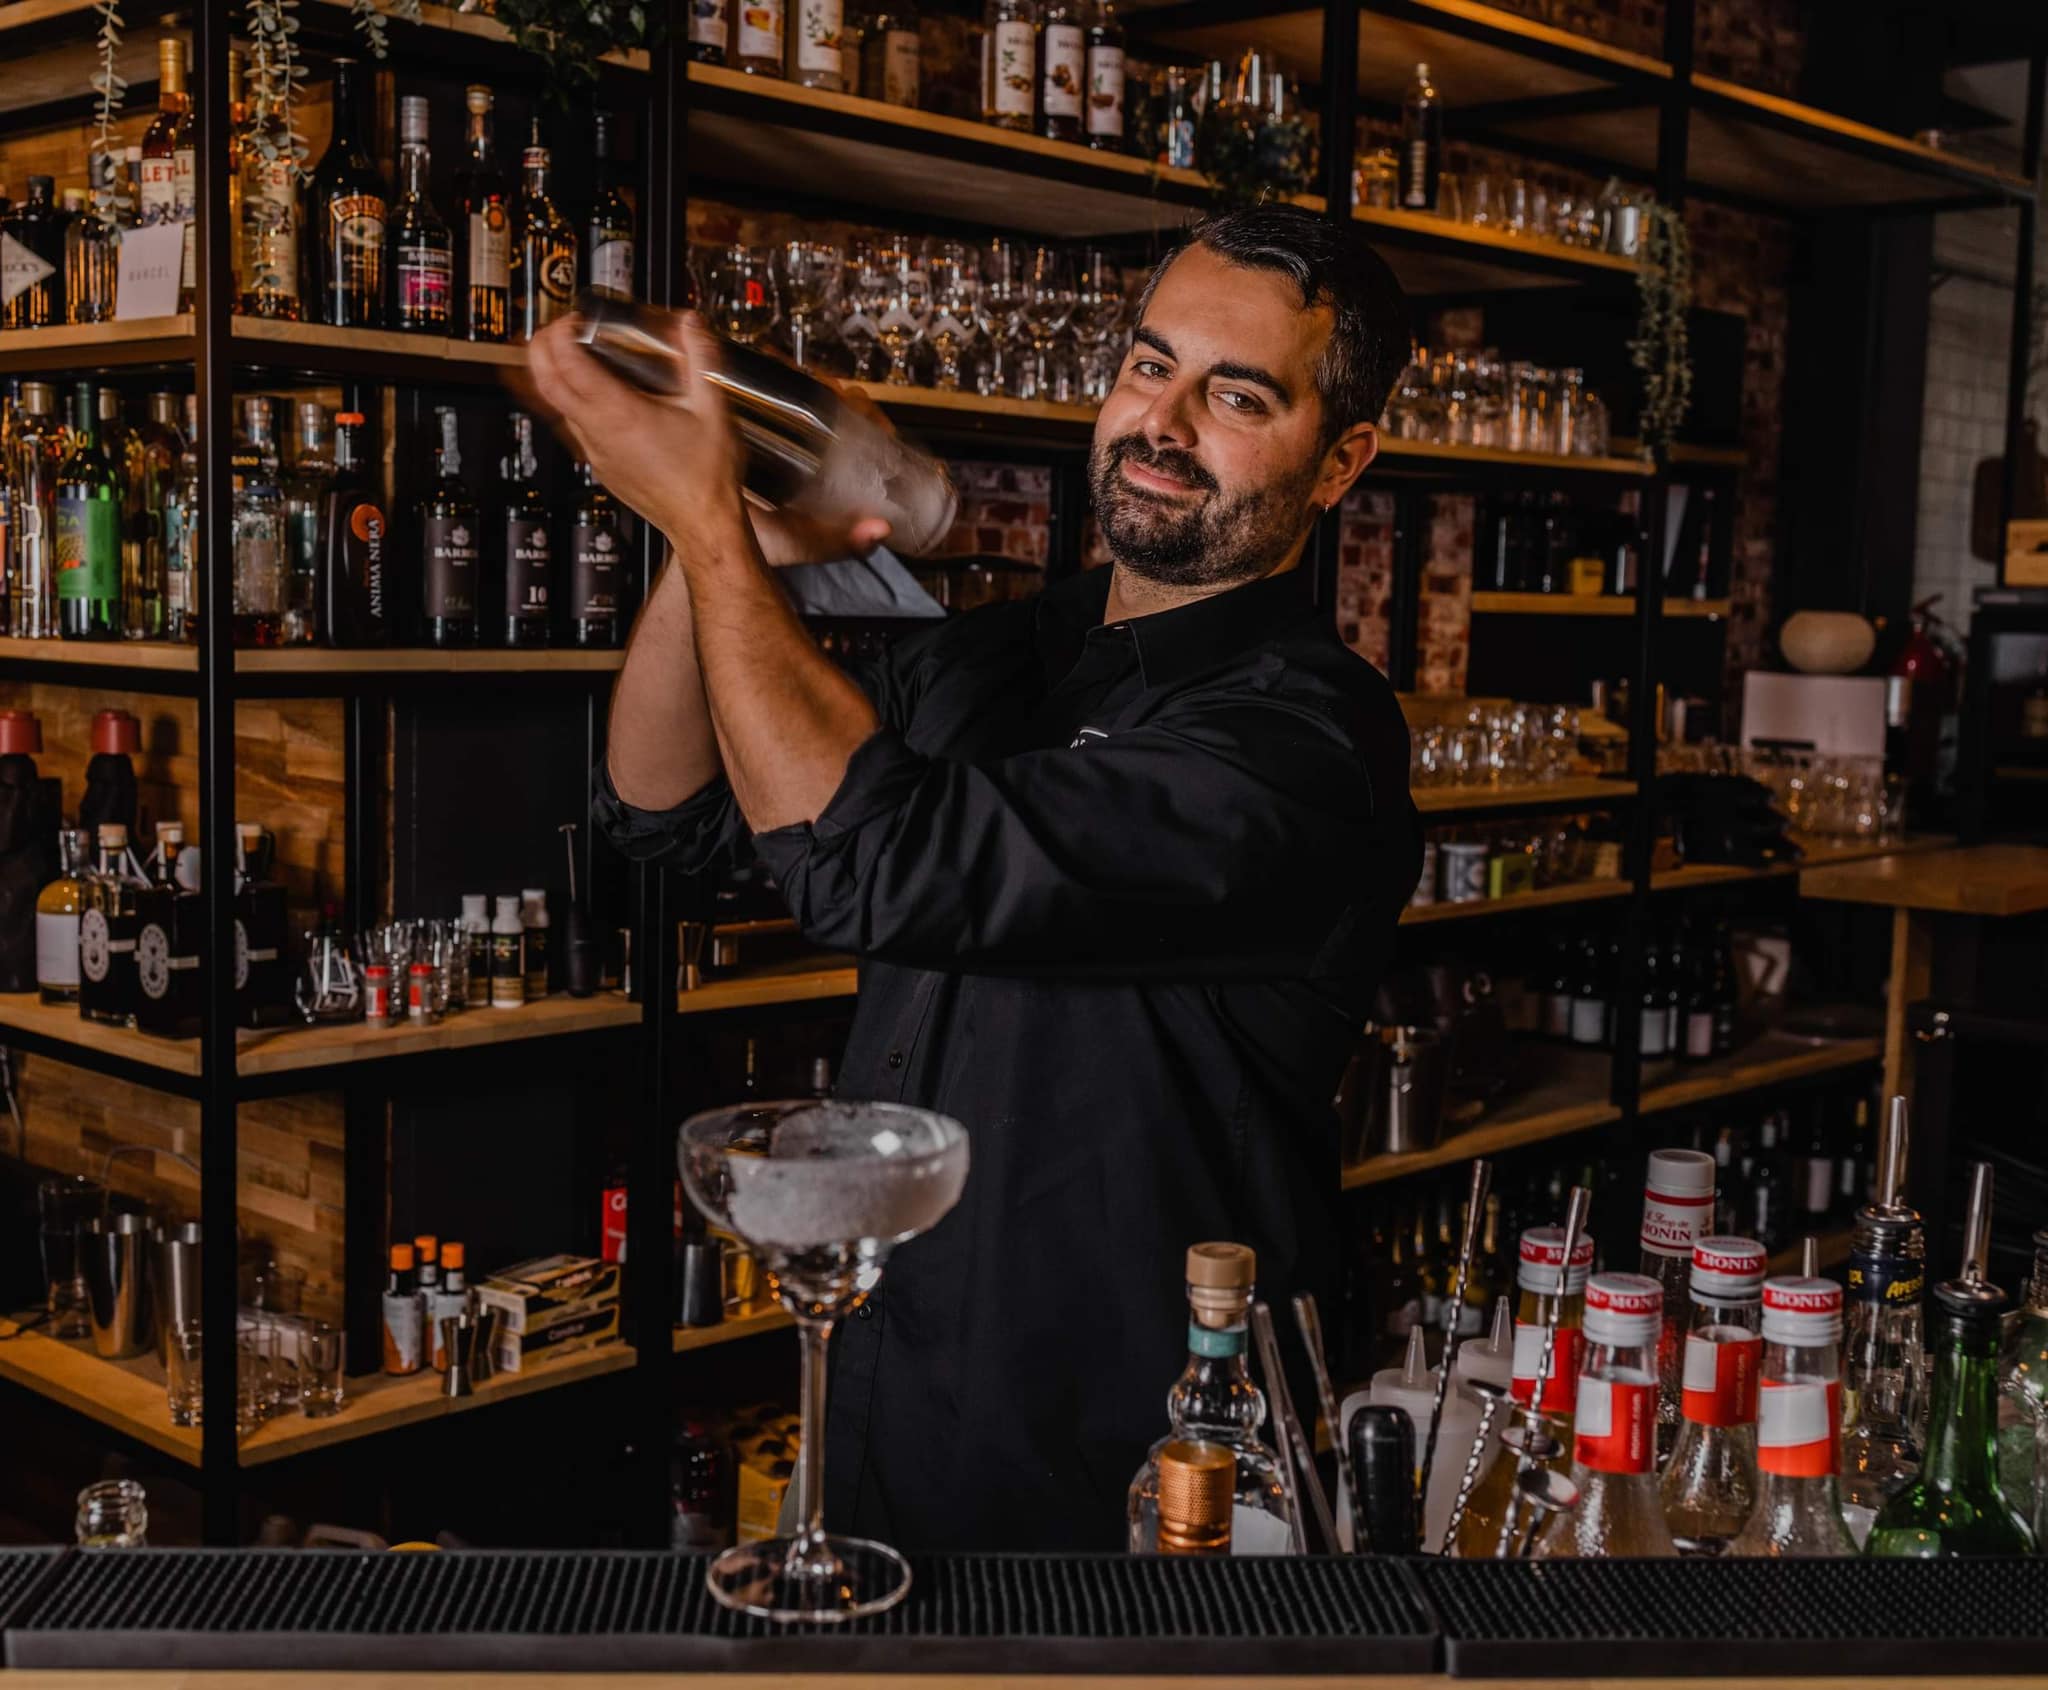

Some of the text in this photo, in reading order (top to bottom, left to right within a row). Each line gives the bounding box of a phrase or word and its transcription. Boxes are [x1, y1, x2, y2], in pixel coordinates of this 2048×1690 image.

[528, 585, 548, 604] 10
[1701, 1252, 1759, 1271] MONIN
[1771, 1290, 1834, 1309] MONIN
